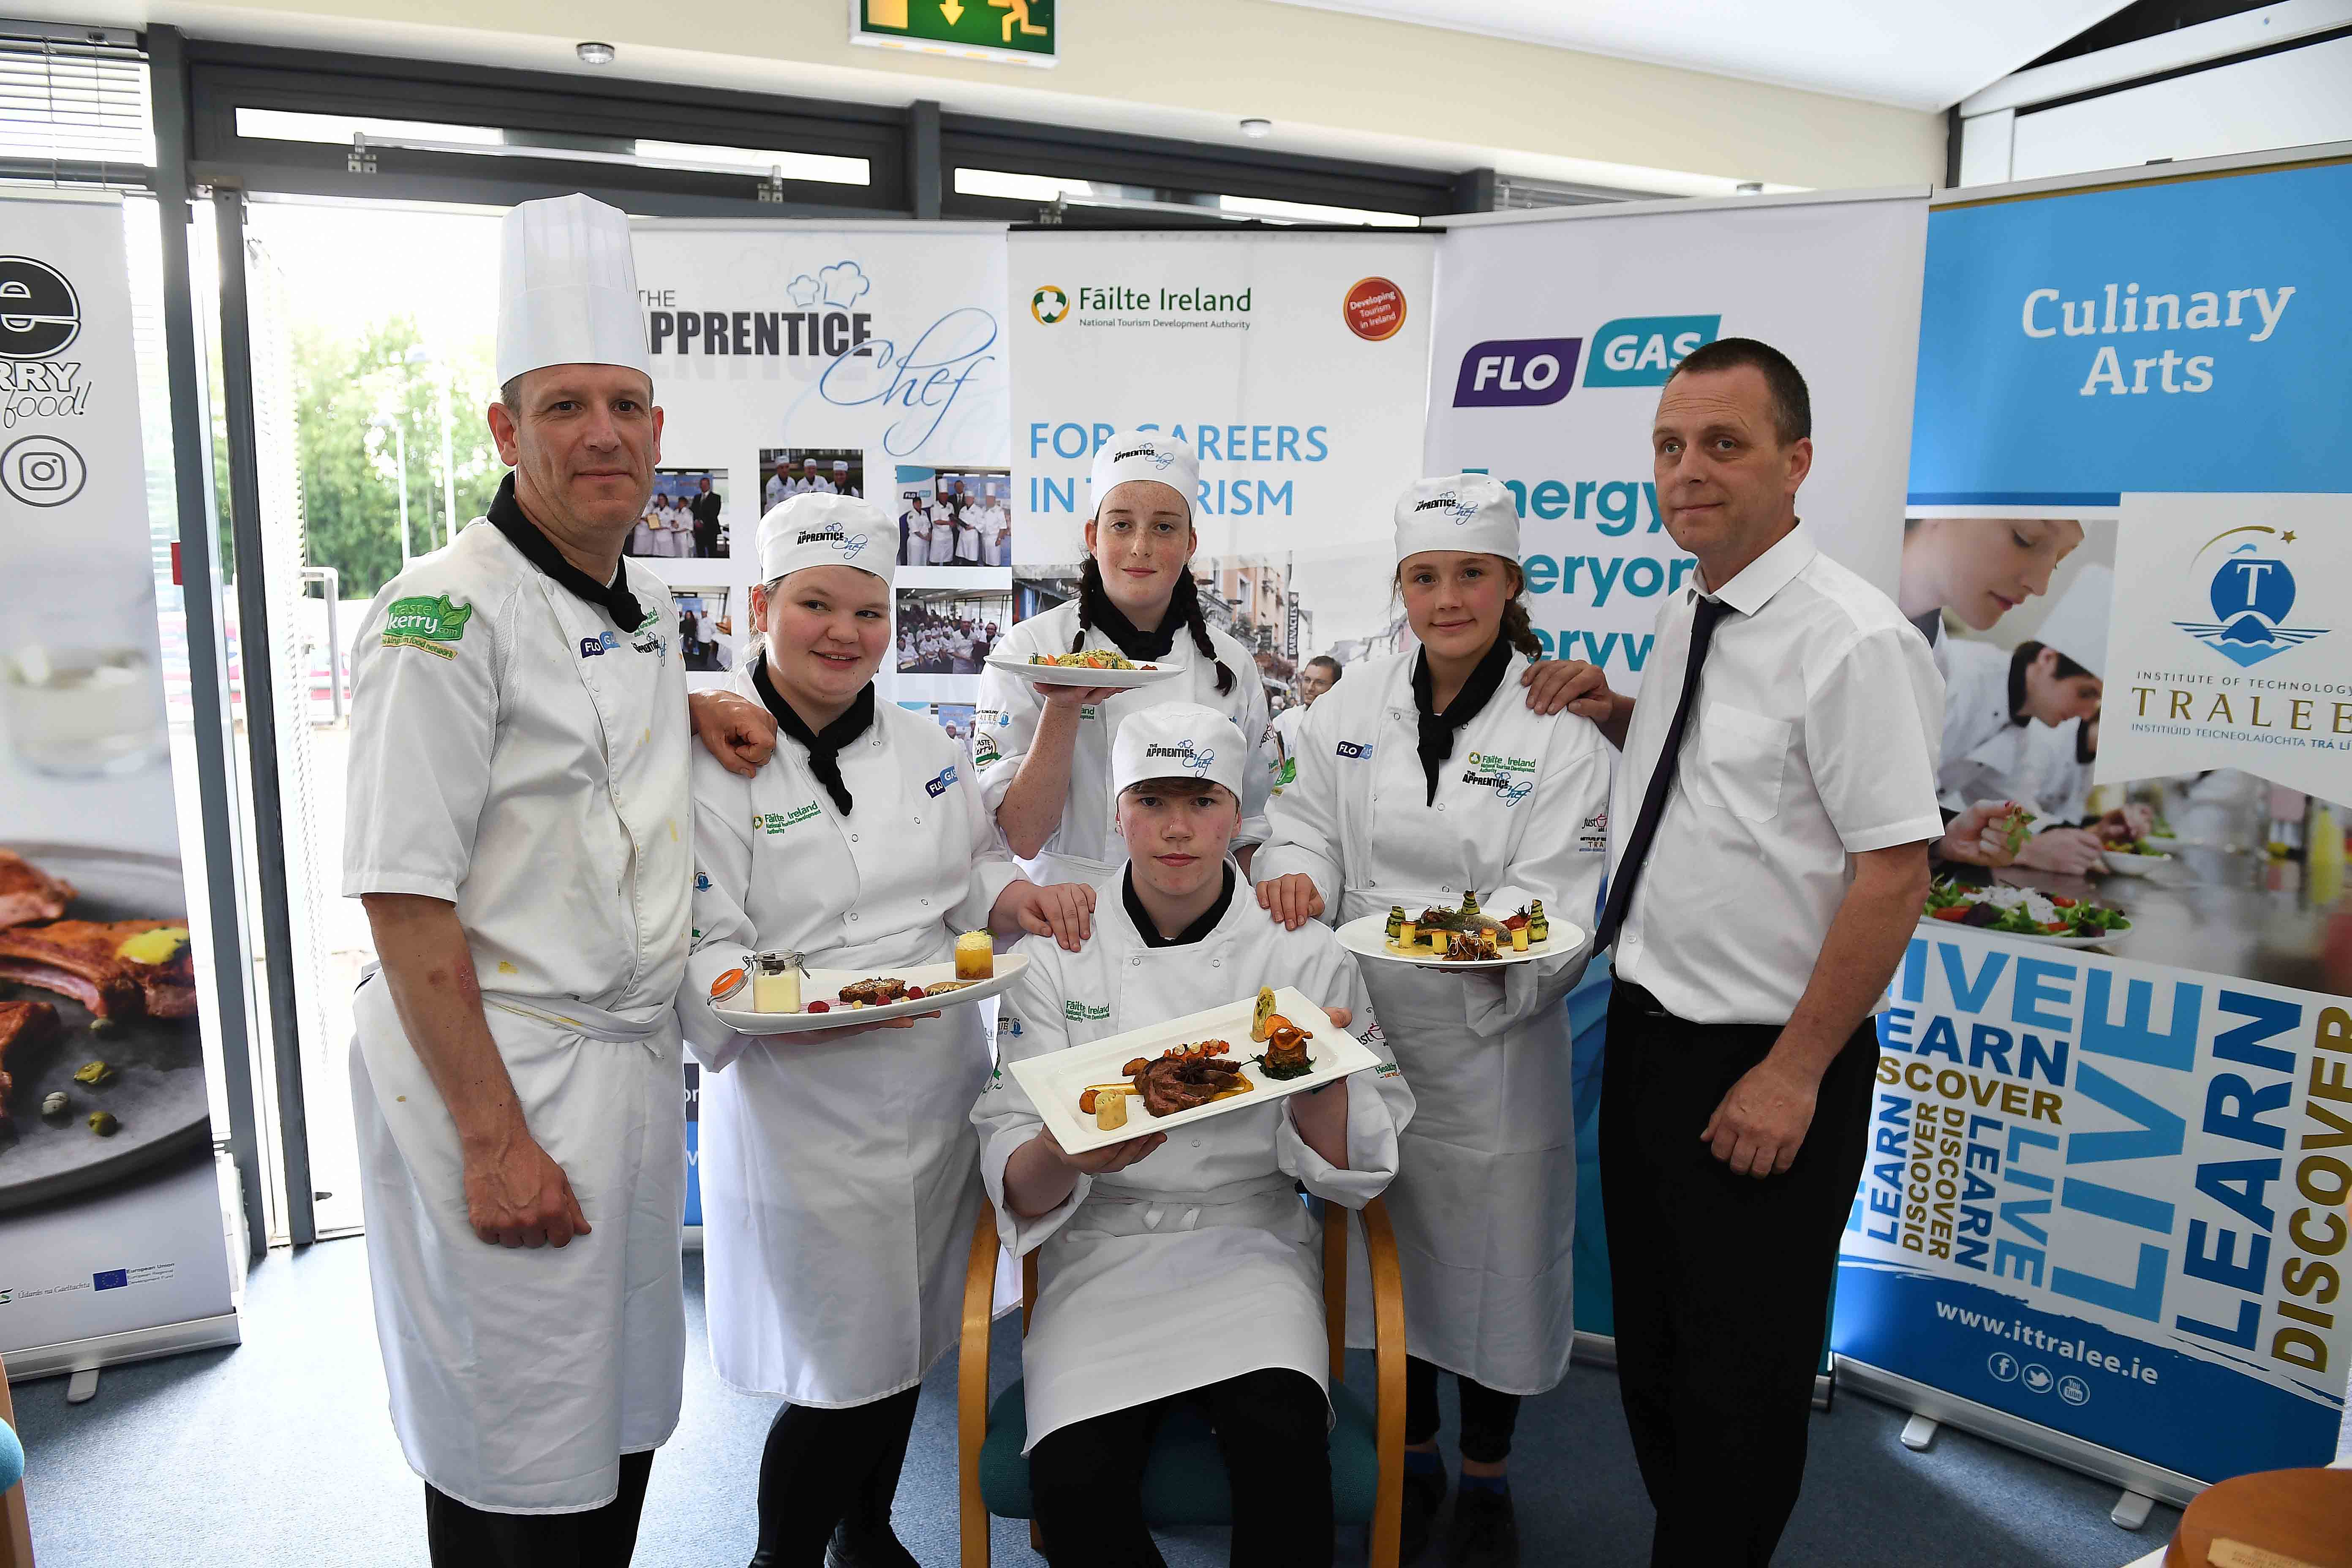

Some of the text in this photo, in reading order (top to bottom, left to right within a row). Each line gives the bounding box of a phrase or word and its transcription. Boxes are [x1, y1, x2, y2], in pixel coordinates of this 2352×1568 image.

[639, 290, 675, 307] THE
[1160, 287, 1251, 312] Ireland
[1349, 291, 1396, 310] Developing
[1359, 304, 1391, 318] Tourism
[1079, 318, 1251, 330] National Tourism Development Authority
[1369, 311, 1396, 326] Ireland
[2023, 283, 2296, 342] Culinary
[649, 311, 872, 357] PPRENTICE
[1473, 332, 1702, 391] FLO GAS
[2080, 346, 2214, 396] Arts
[819, 308, 997, 456] Chef
[4, 381, 92, 428] food!
[1135, 422, 1328, 462] REERS
[1113, 449, 1155, 463] APPRENTICE
[1031, 477, 1074, 513] IN
[1414, 499, 1456, 512] APPRENTICE
[1462, 468, 1663, 536] nergy
[1444, 501, 1478, 525] Chef
[797, 532, 844, 545] APPRENTICE
[831, 534, 868, 560] Chef
[2237, 564, 2272, 605] T
[395, 604, 433, 615] taste
[387, 612, 438, 634] kerry
[1289, 605, 1298, 654] BARNACLES
[585, 642, 601, 652] FLO
[2137, 671, 2214, 685] INSTITUTE
[2223, 677, 2240, 686] OF
[2132, 687, 2352, 734] TRALEE
[2132, 723, 2191, 736] INSTITIÚID
[2197, 727, 2305, 747] TEICNEOLAÍOCHTA
[2311, 735, 2334, 749] TRÁ
[976, 745, 993, 755] erry
[1146, 748, 1194, 758] APPRENTICE
[1339, 744, 1358, 755] FLO
[1508, 757, 1536, 768] Ireland
[1182, 749, 1215, 778] Chef
[929, 781, 943, 793] FLO
[1462, 774, 1510, 789] APPRENTICE
[1496, 781, 1533, 807] Chef
[787, 800, 818, 819] Ireland
[795, 809, 822, 822] Development
[1903, 939, 2077, 1033] IVE
[1088, 1003, 1109, 1014] Ireland
[1876, 1007, 2070, 1087] EARN
[1375, 1062, 1397, 1074] Healthy
[1876, 1056, 2064, 1125] SCOVER
[2050, 967, 2204, 1324] LIVE
[1867, 1093, 1912, 1244] LEARN
[1903, 1102, 1939, 1253] DISCOVER
[2175, 990, 2303, 1352] LEARN
[1928, 1106, 1966, 1260] DISCOVER
[1954, 1114, 2004, 1271] LEARN
[2271, 1006, 2352, 1374] DISCOVER
[1993, 1125, 2060, 1288] LIVE
[126, 1266, 155, 1274] European
[54, 1282, 90, 1293] Gaeltachta
[1936, 1301, 2159, 1386] www.ittralee.ie
